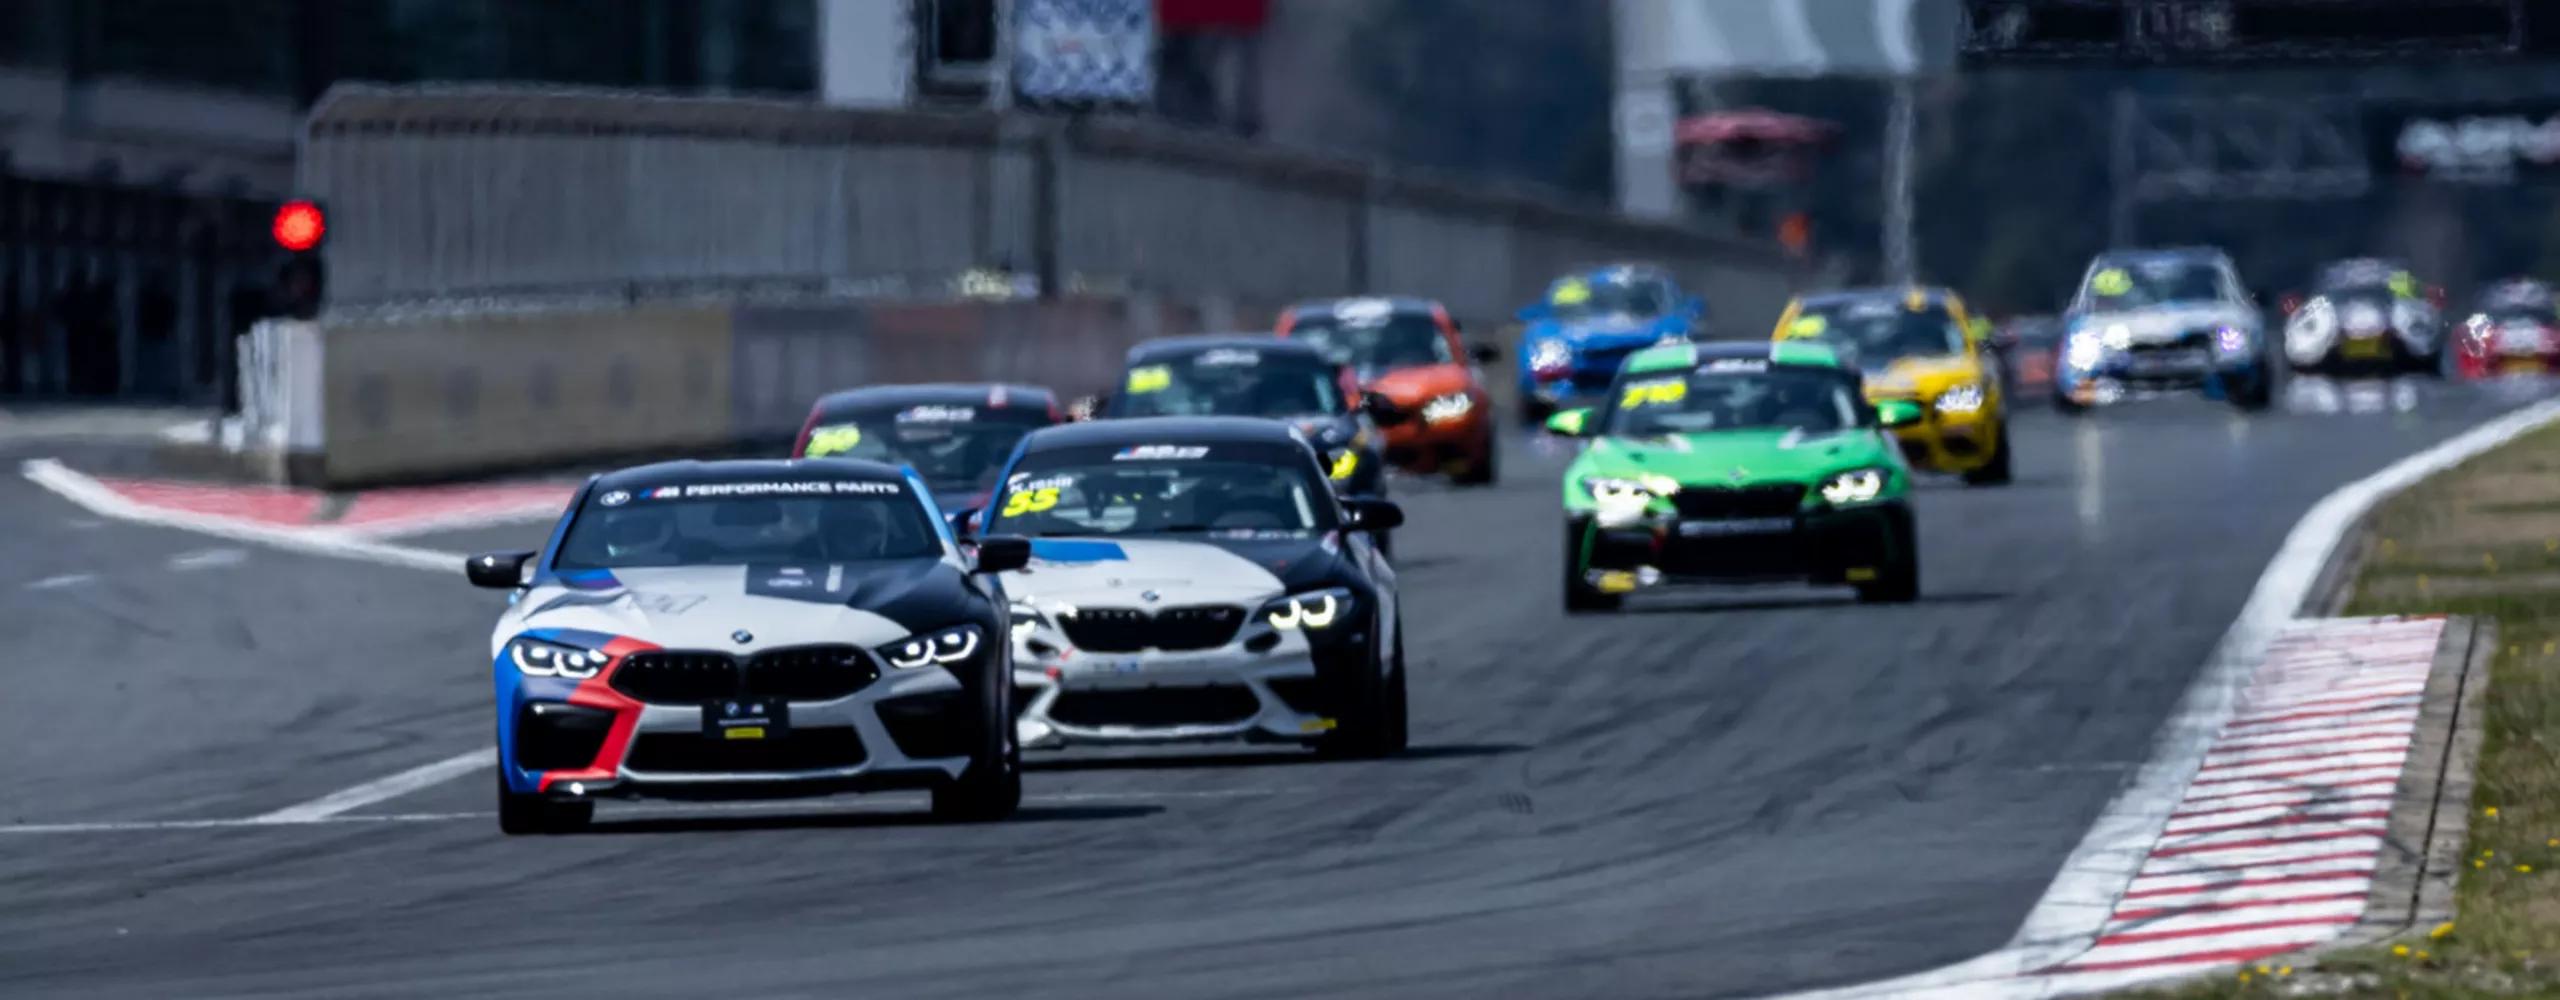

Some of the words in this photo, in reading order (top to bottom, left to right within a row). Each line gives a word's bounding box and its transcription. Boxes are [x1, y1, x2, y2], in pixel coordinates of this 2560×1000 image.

[685, 481, 832, 497] PERFORMANCE
[834, 481, 900, 494] PARTS
[1002, 487, 1060, 517] 55
